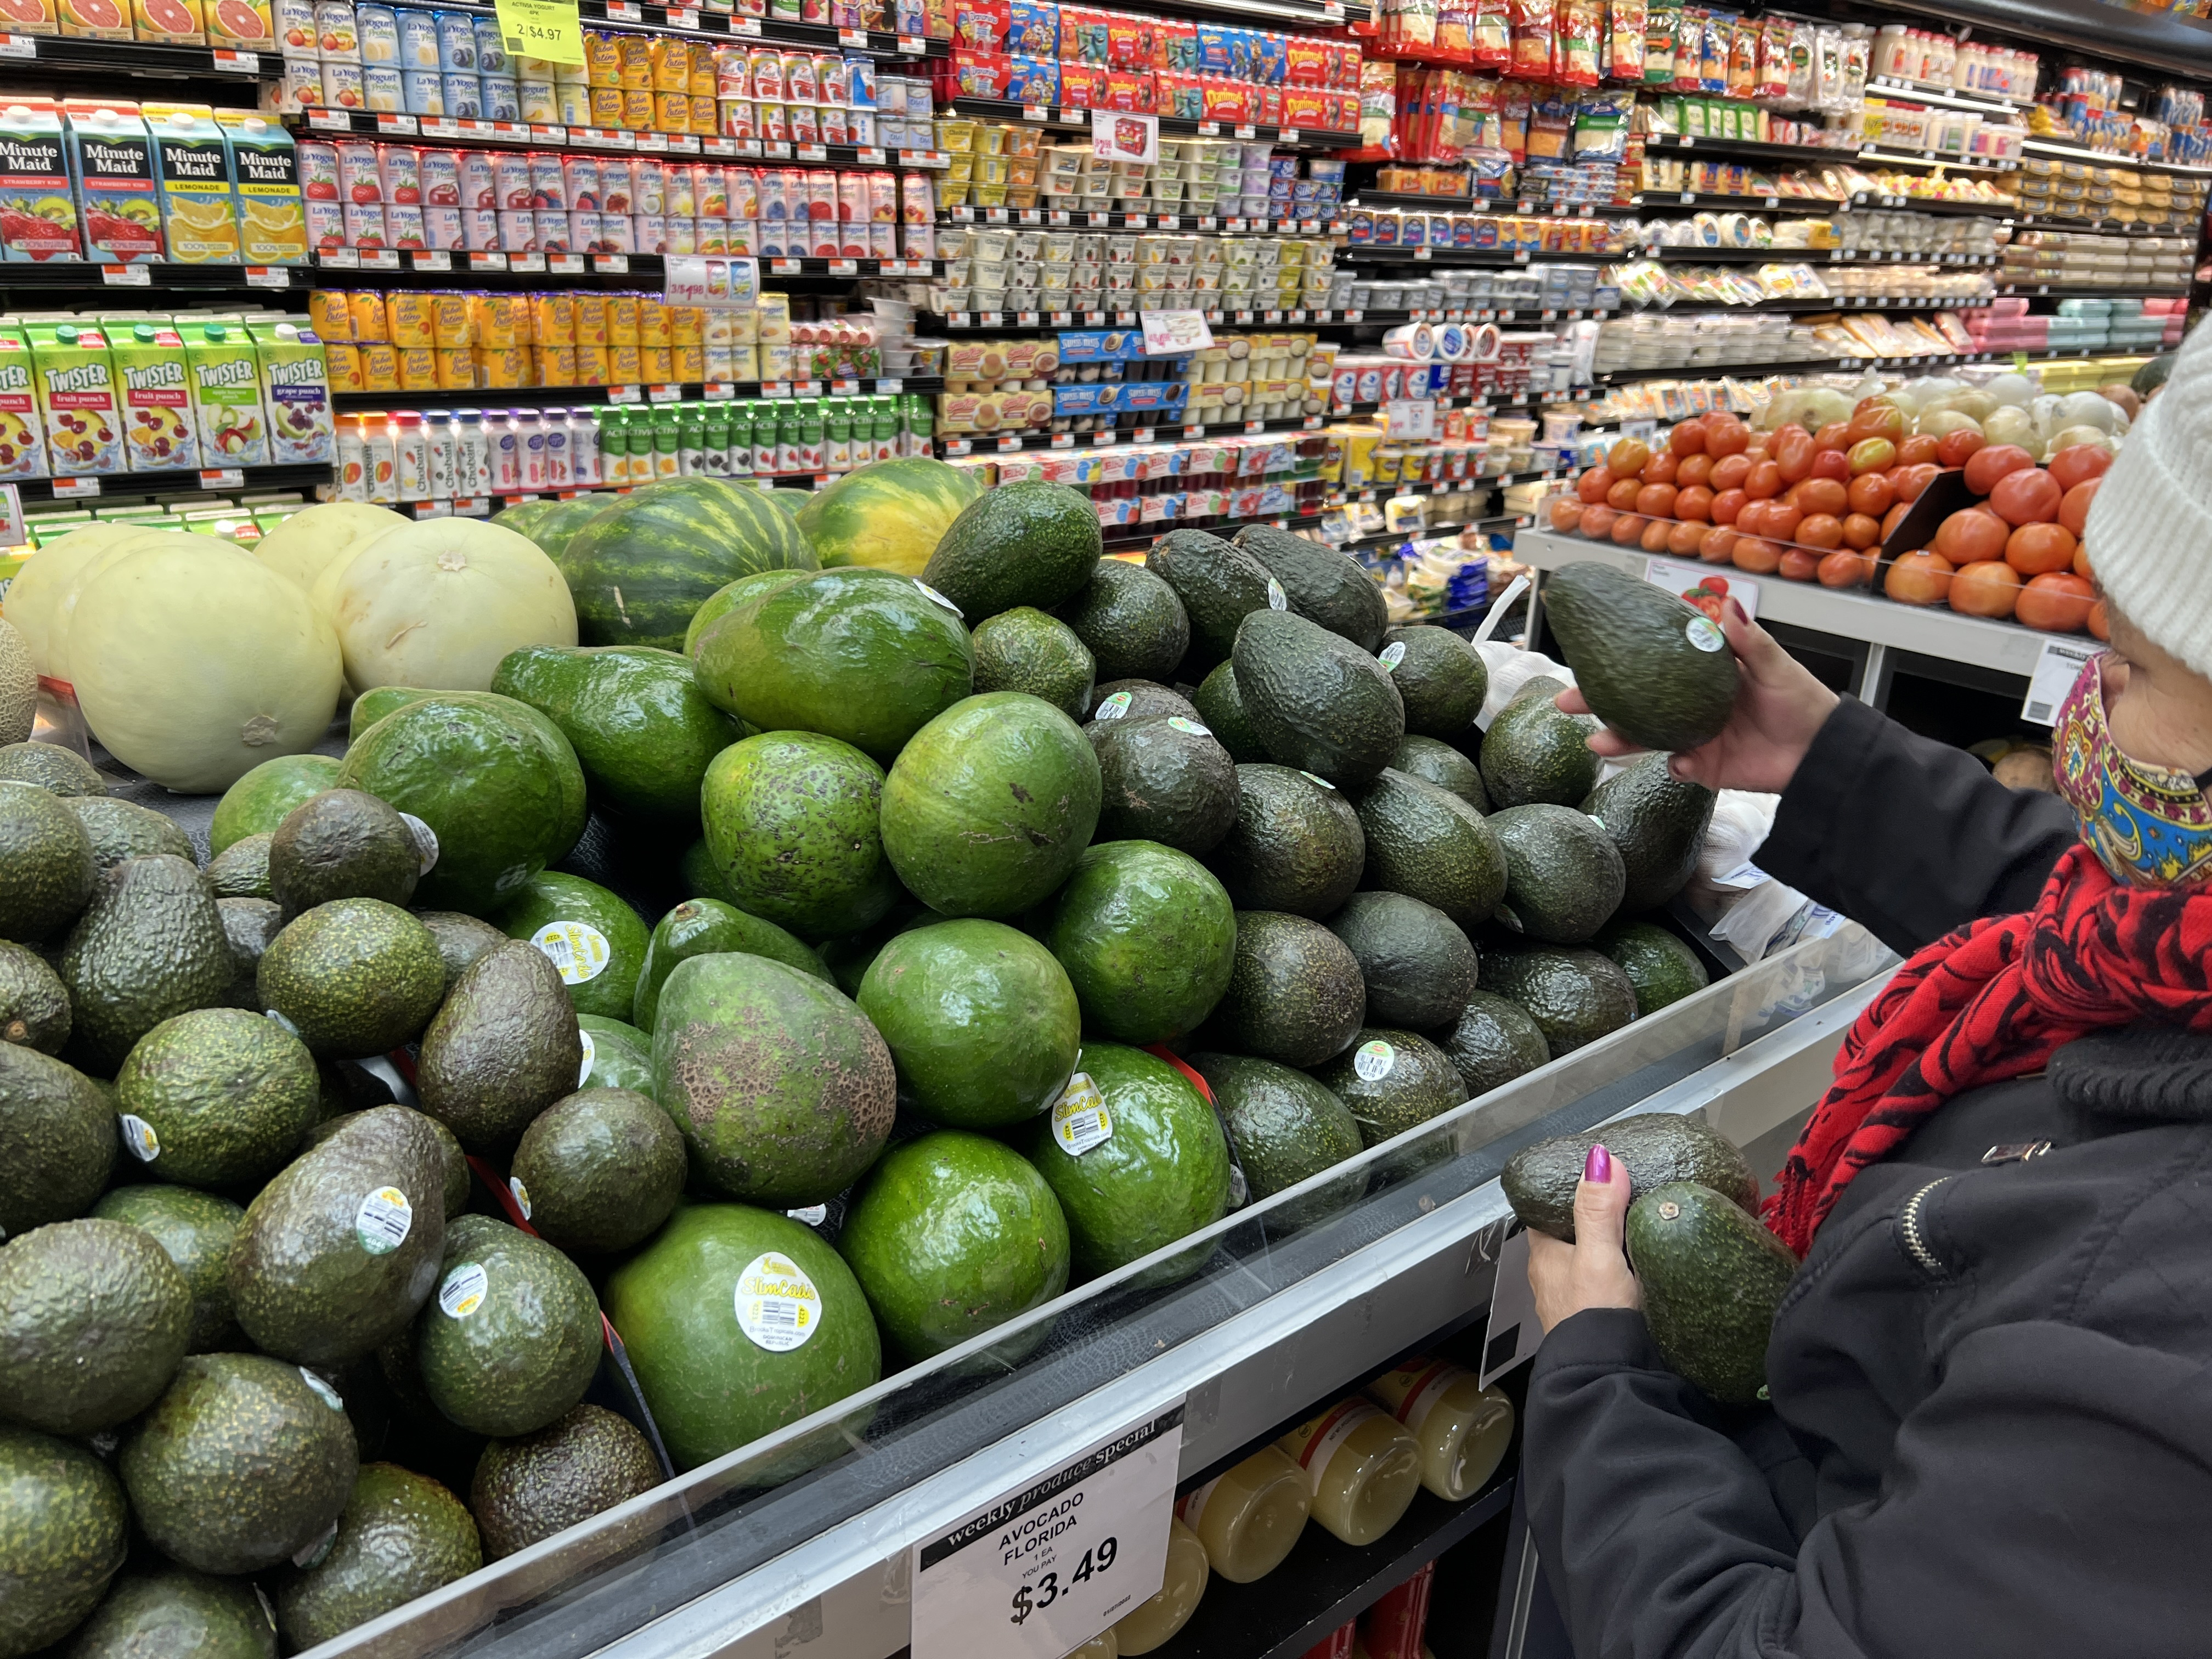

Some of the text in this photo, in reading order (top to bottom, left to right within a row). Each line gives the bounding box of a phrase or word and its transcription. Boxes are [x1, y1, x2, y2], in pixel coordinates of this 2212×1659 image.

[0, 142, 58, 157] Minute
[84, 143, 144, 160] Minute
[165, 147, 221, 163] Minute
[7, 156, 53, 171] Maid
[95, 158, 139, 173] Maid
[239, 151, 292, 167] Minute
[176, 161, 217, 177] Maid
[249, 165, 287, 180] Maid
[1280, 161, 1295, 175] Sil
[1319, 184, 1334, 197] ilk
[276, 387, 321, 396] grape punch
[566, 924, 592, 978] SlimCado
[742, 1276, 816, 1300] SlimCado
[948, 1420, 1155, 1547] weekly produce special
[998, 1492, 1084, 1550] AVOCADO
[1003, 1515, 1077, 1566] FLORIDA
[1041, 1545, 1053, 1558] EA
[1022, 1554, 1057, 1579] YOU PAY
[1010, 1537, 1118, 1626] $3.49
